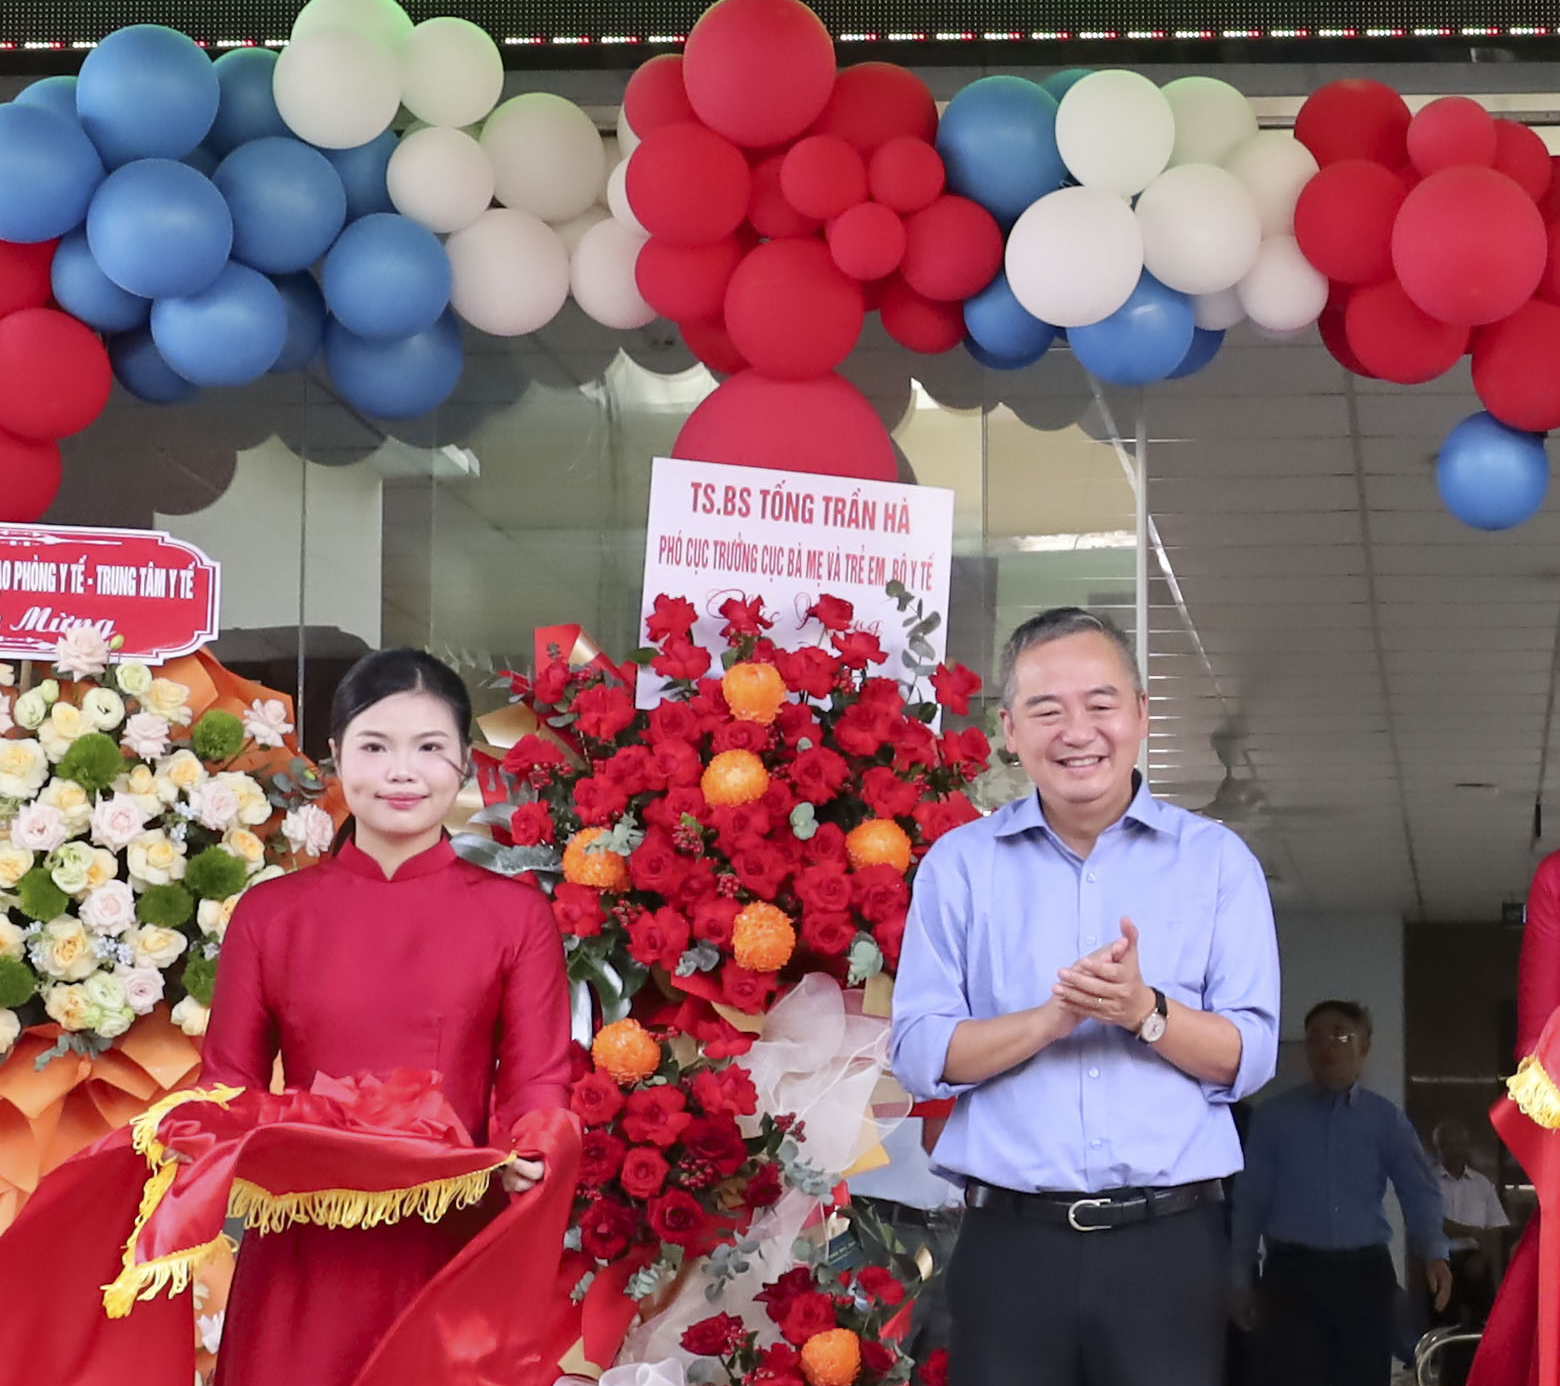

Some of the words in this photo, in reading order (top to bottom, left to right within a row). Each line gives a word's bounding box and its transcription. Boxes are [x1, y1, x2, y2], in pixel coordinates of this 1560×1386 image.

[690, 481, 752, 518] TS.BS
[760, 479, 815, 525] TỐNG
[822, 488, 877, 531] TRẦN
[883, 497, 911, 535] HÀ
[13, 555, 57, 594] PHÒNG
[58, 563, 69, 594] Y
[70, 555, 88, 594] TẾ
[96, 565, 137, 596] TRUNG
[139, 561, 167, 598] TÂM
[167, 568, 178, 599] Y
[179, 561, 196, 600] TẾ
[658, 529, 683, 566] PHÓ
[685, 537, 709, 575] CỤC
[712, 531, 758, 574] TRƯỞNG
[761, 544, 785, 583] CỤC
[786, 541, 803, 579] BÀ
[805, 549, 824, 587] MẸ
[827, 545, 841, 582] VÀ
[845, 544, 865, 585] TRẺ
[910, 560, 918, 589] Y
[920, 552, 934, 592] TẾ
